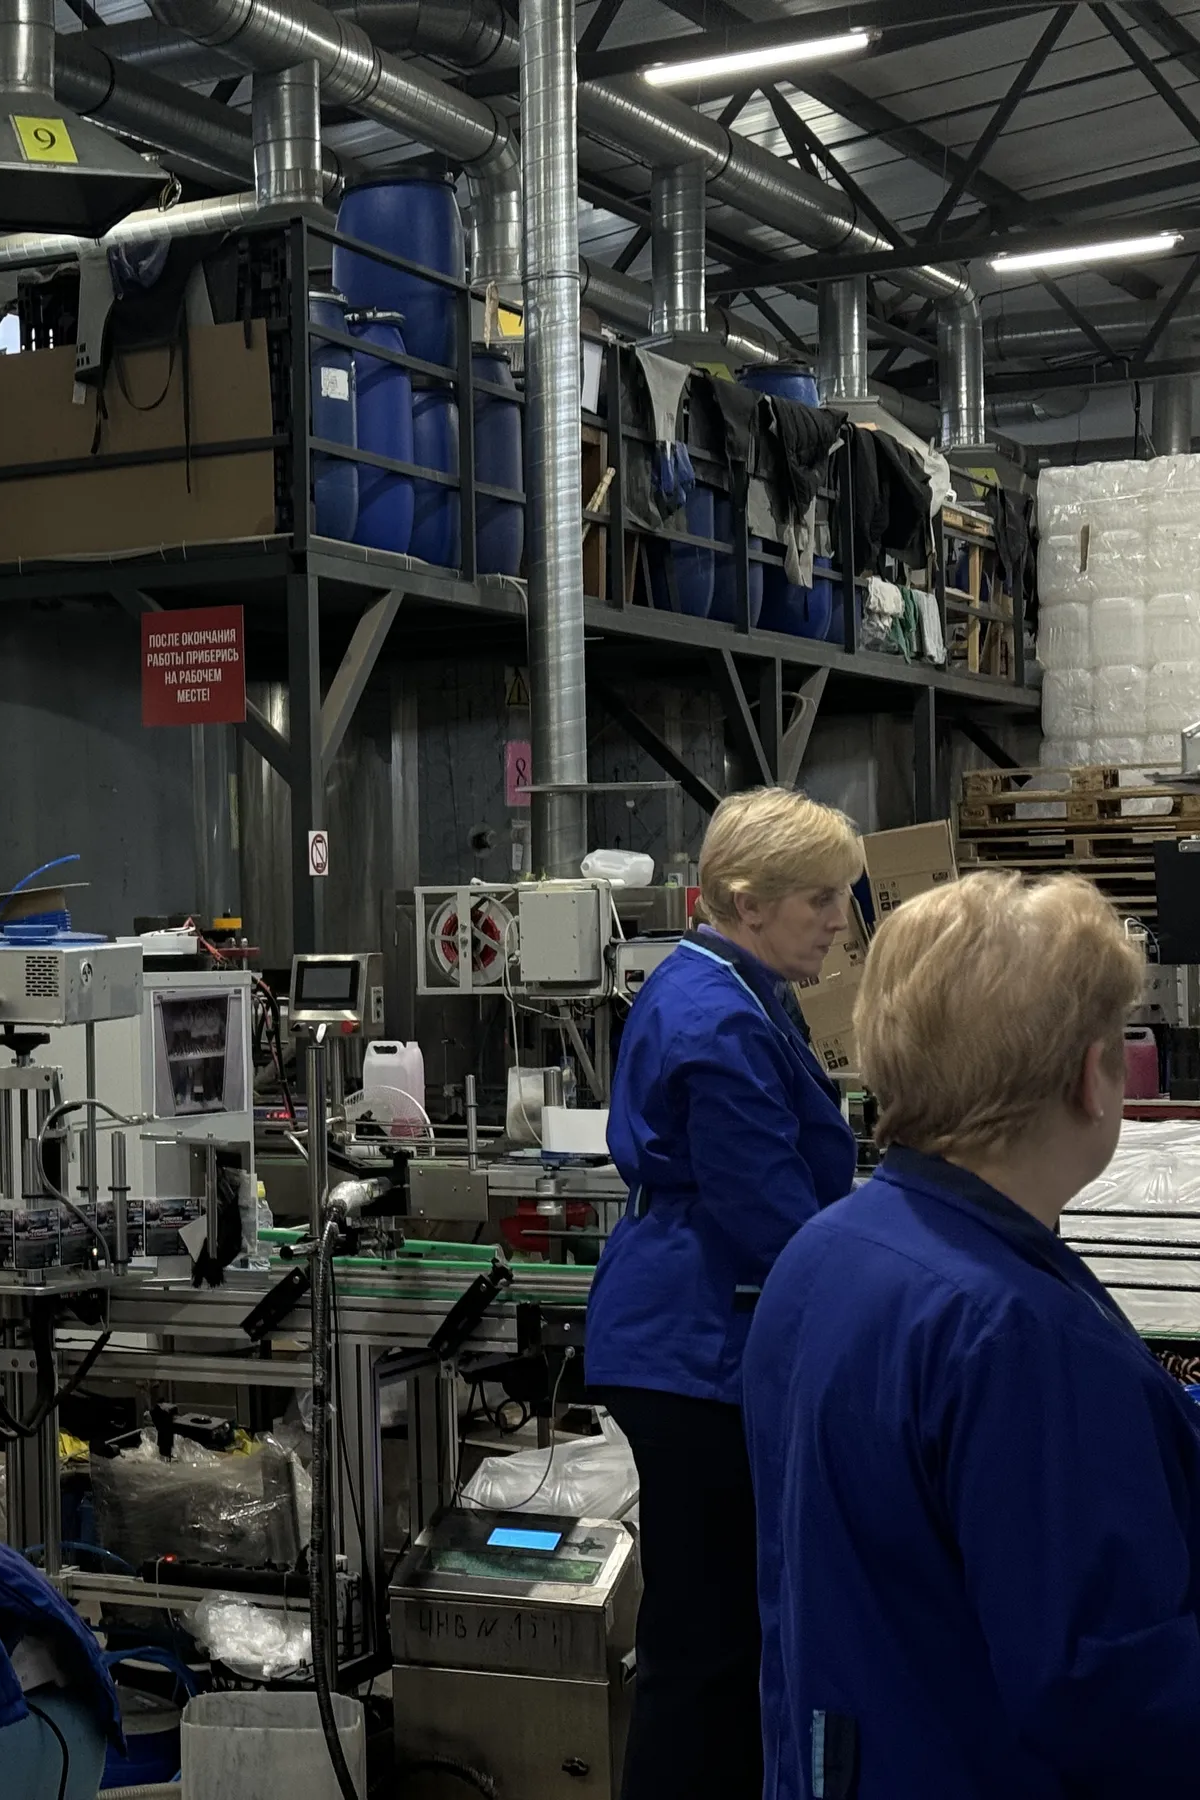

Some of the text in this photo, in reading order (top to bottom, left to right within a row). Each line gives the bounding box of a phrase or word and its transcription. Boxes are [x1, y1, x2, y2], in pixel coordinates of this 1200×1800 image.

[33, 127, 56, 151] 9
[149, 628, 236, 648] ПОСЛЕ ОКОНЧАНИЯ
[147, 647, 239, 667] РАБОТЫ ПРИБЕРИСЬ
[164, 667, 222, 685] НА РАБОЧЕМ
[177, 687, 210, 703] МЕСТЕ!
